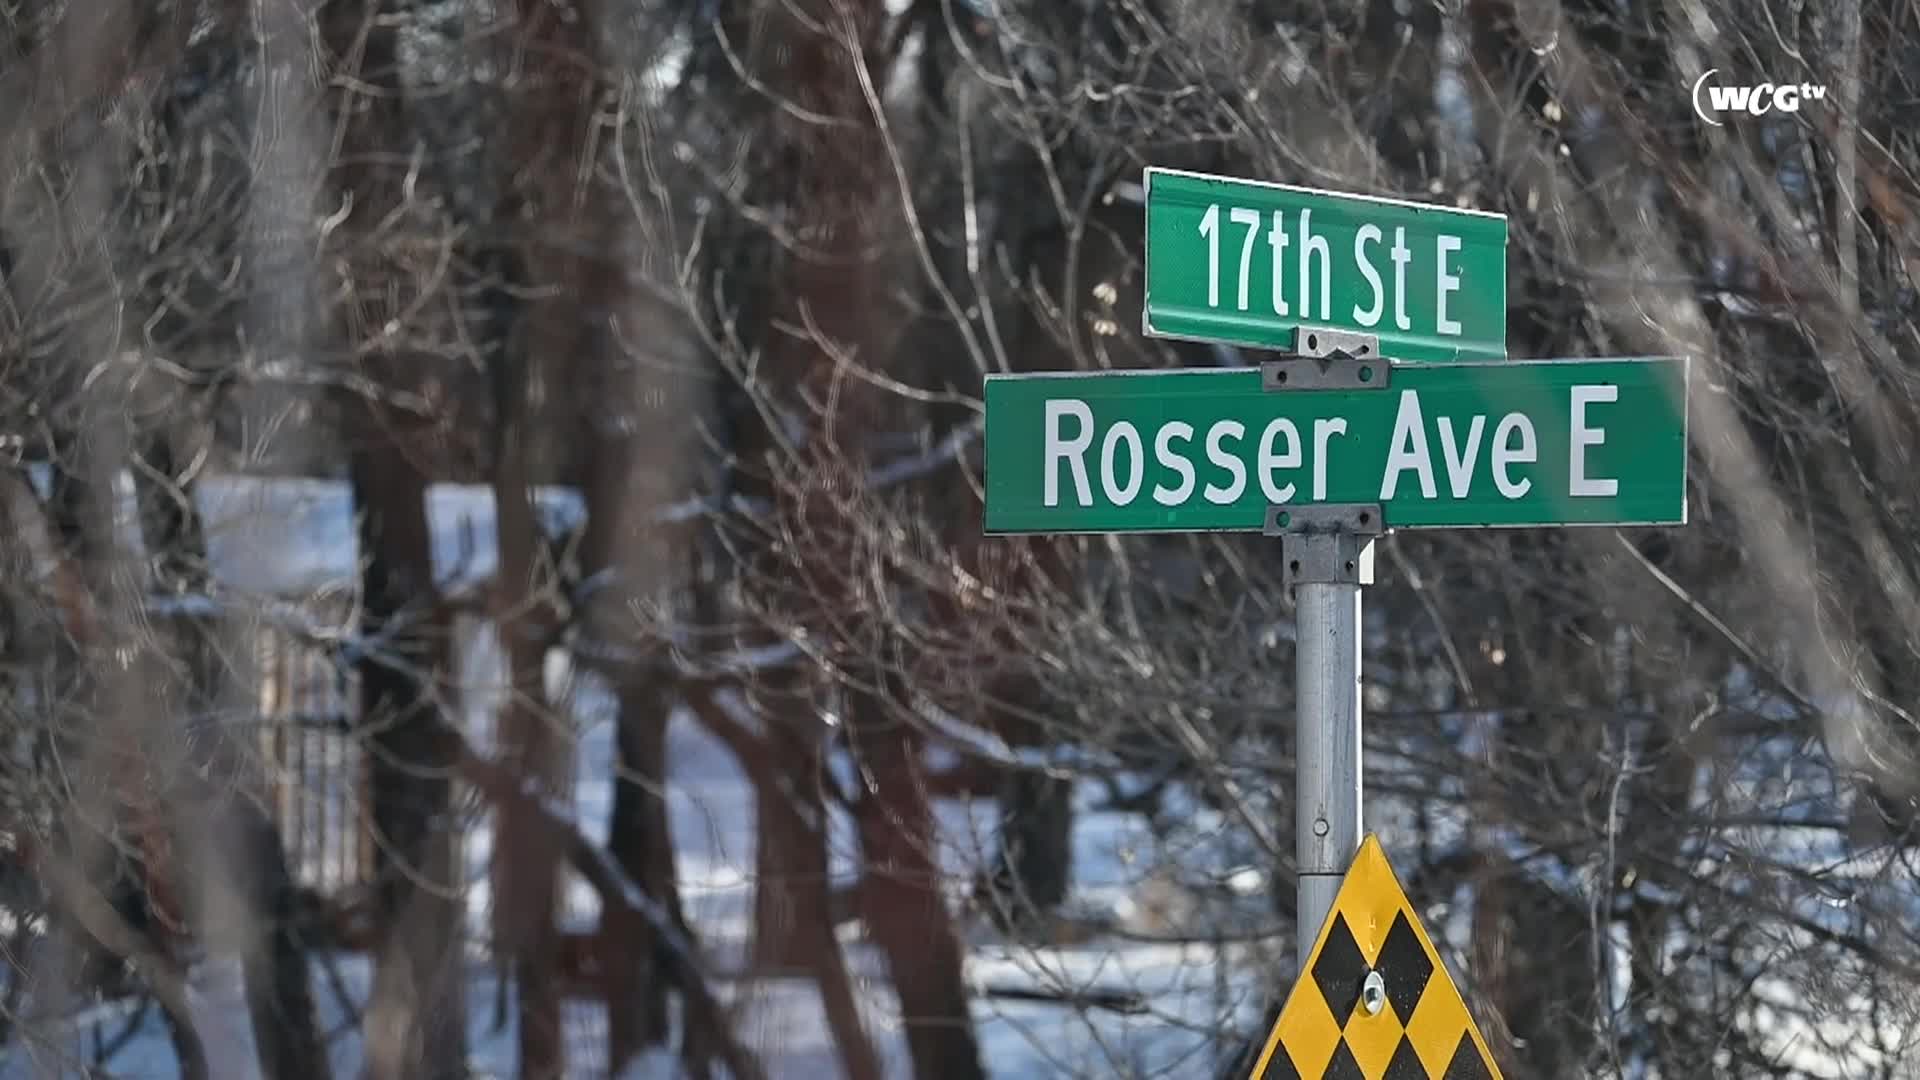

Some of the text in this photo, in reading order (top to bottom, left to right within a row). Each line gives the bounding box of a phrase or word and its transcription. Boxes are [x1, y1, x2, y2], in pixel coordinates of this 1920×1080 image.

[1198, 204, 1463, 336] 17th St E
[1043, 385, 1620, 507] Rosser Ave E
